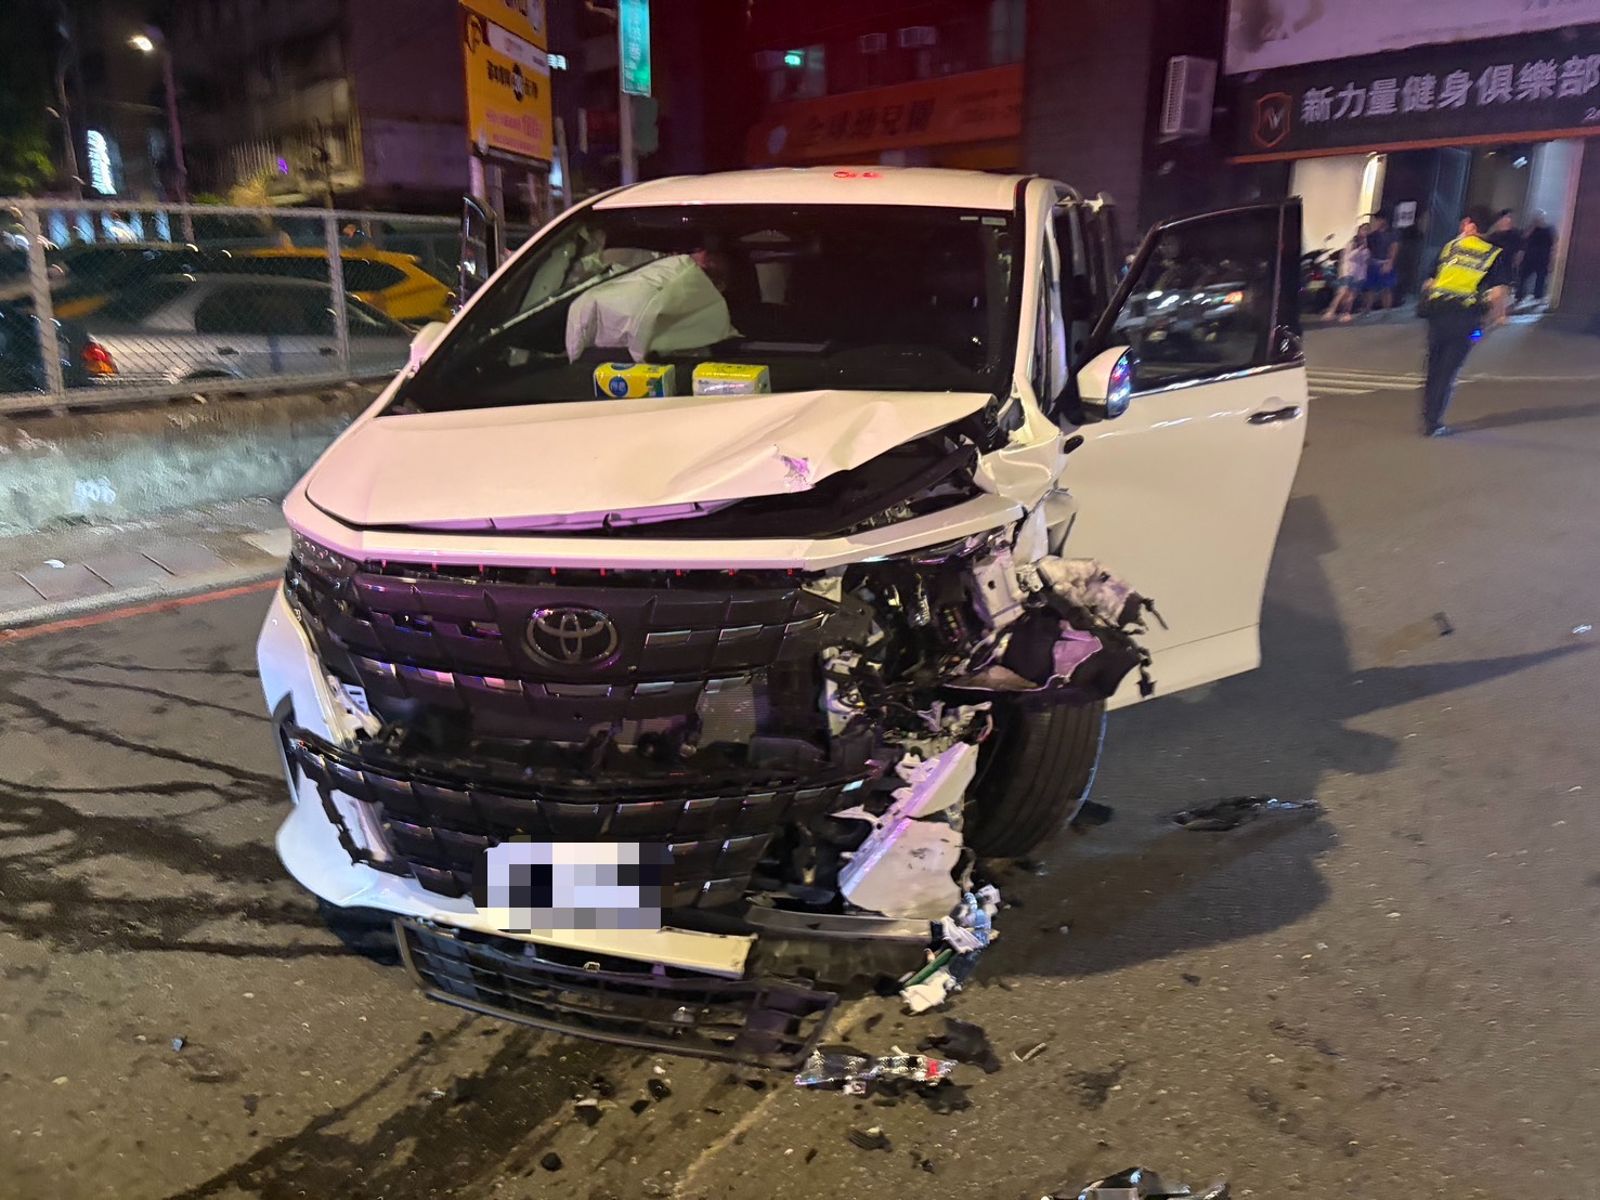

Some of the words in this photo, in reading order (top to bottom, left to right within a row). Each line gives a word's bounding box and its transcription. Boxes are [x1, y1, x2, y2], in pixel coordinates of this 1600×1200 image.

[1301, 54, 1600, 124] 新力量健身俱樂部
